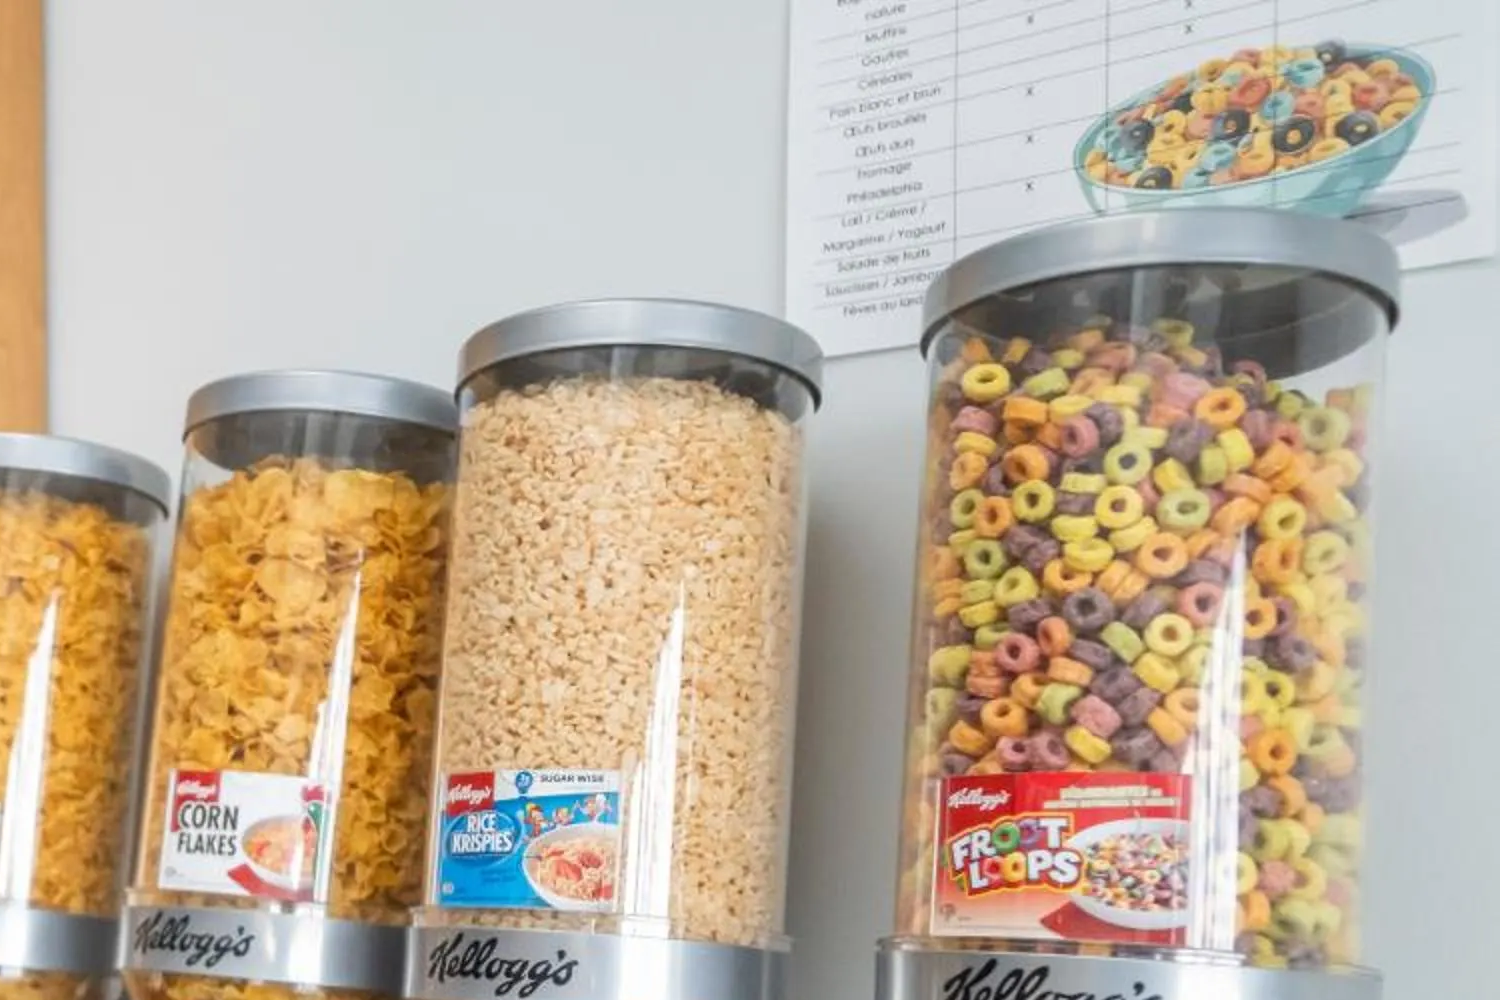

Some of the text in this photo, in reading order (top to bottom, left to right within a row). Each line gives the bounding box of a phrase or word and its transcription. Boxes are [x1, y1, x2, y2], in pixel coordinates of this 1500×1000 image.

[178, 802, 240, 832] CORN
[466, 813, 497, 832] RICE
[176, 831, 238, 856] FLAKES
[451, 829, 514, 855] KRISPIES
[951, 816, 1071, 871] FROOT
[969, 849, 1083, 890] LOOPS
[134, 911, 255, 968] Kellogg's
[428, 932, 579, 998] Kellogg's
